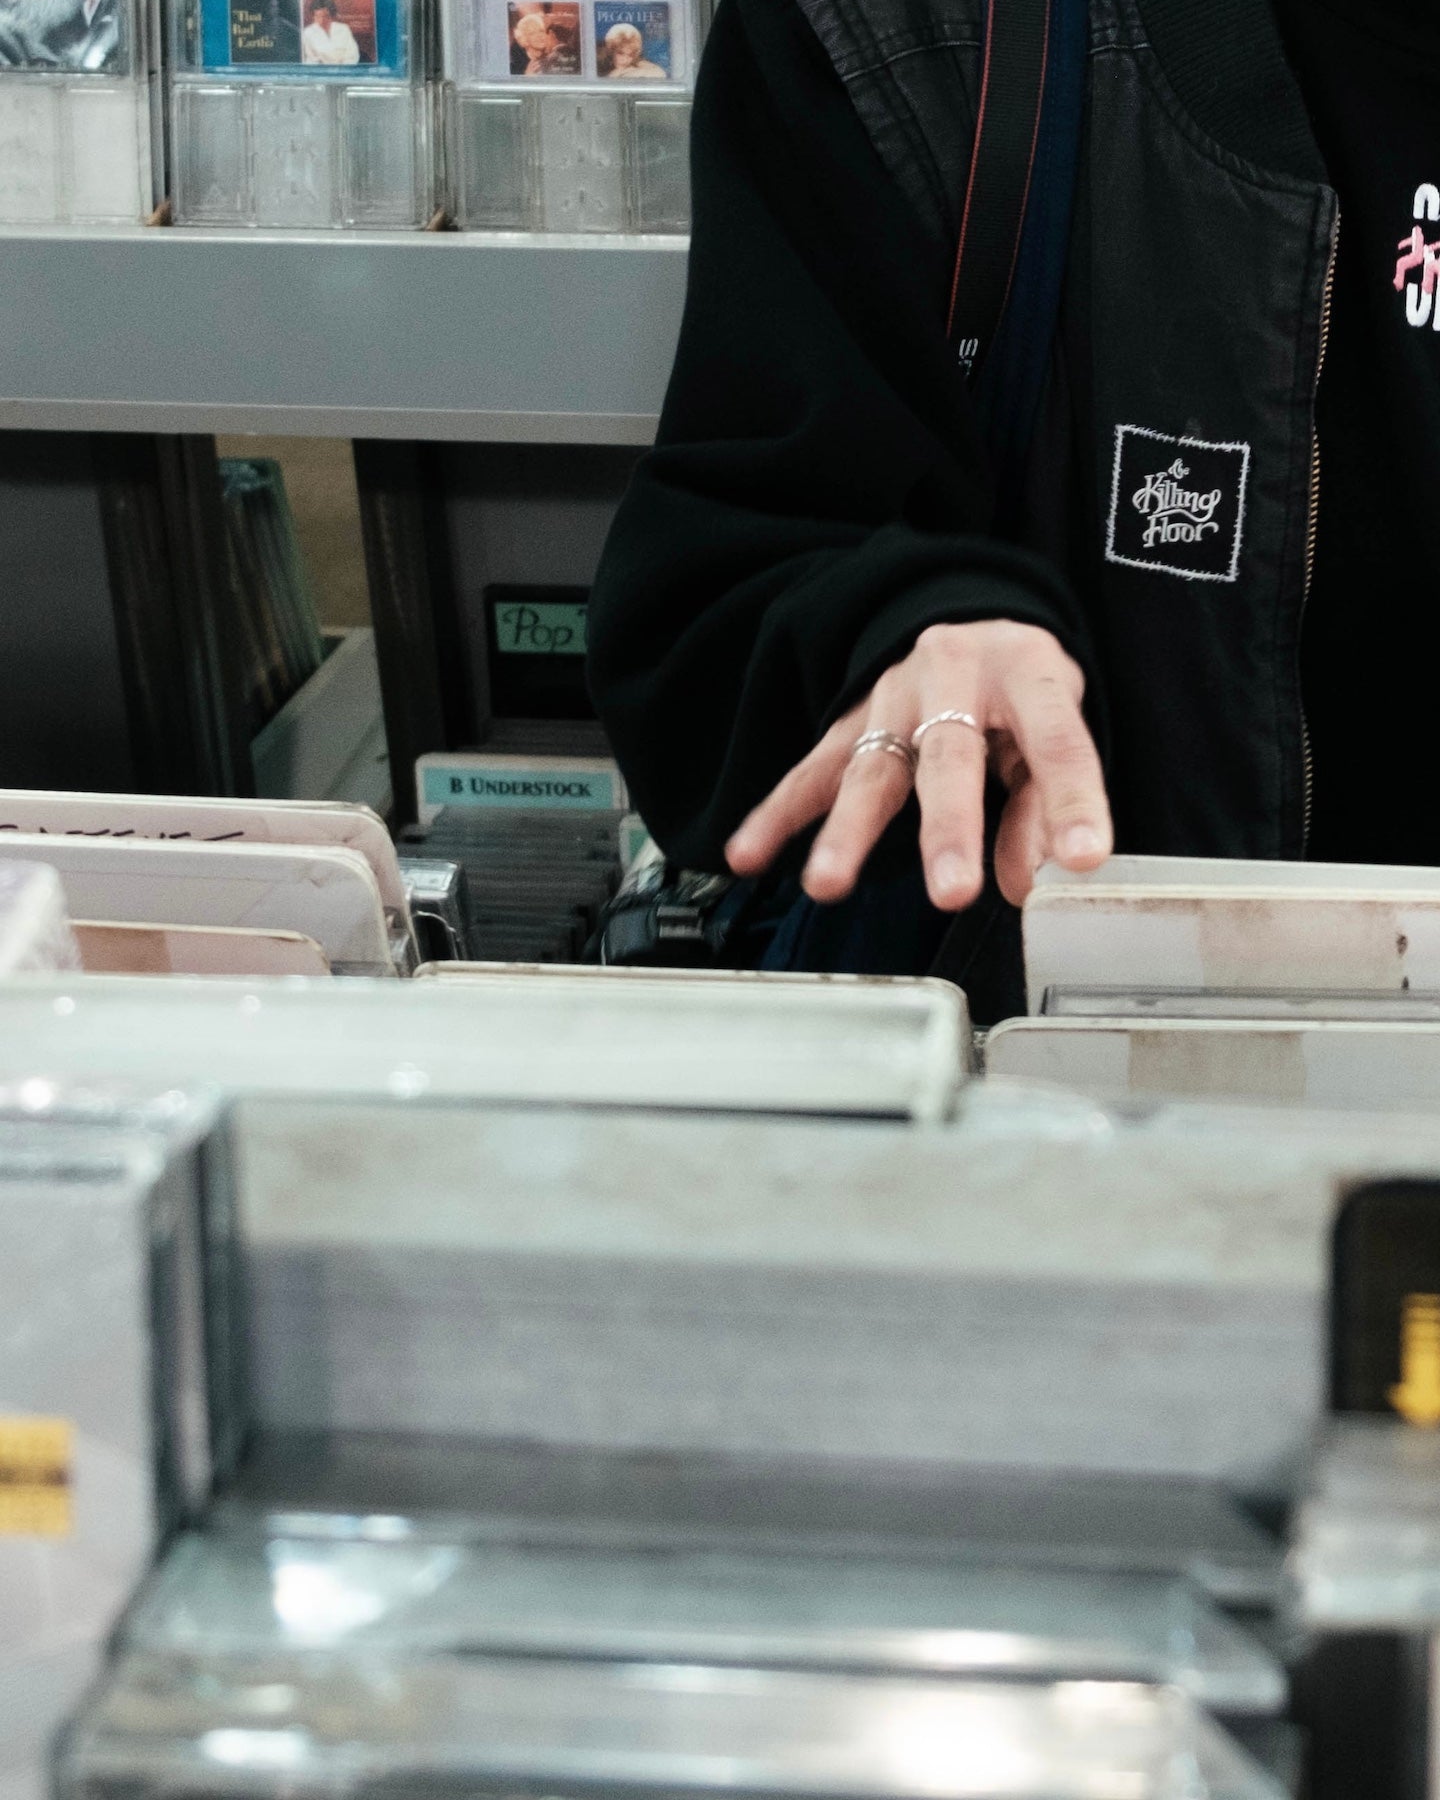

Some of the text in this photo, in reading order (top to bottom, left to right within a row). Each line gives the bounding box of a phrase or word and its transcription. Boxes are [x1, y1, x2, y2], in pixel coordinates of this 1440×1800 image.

[596, 10, 633, 22] PEGGY
[1131, 471, 1222, 524] Killing
[1142, 516, 1220, 549] Floor
[502, 605, 574, 650] Pop
[450, 776, 592, 798] B UNDERSTOCK
